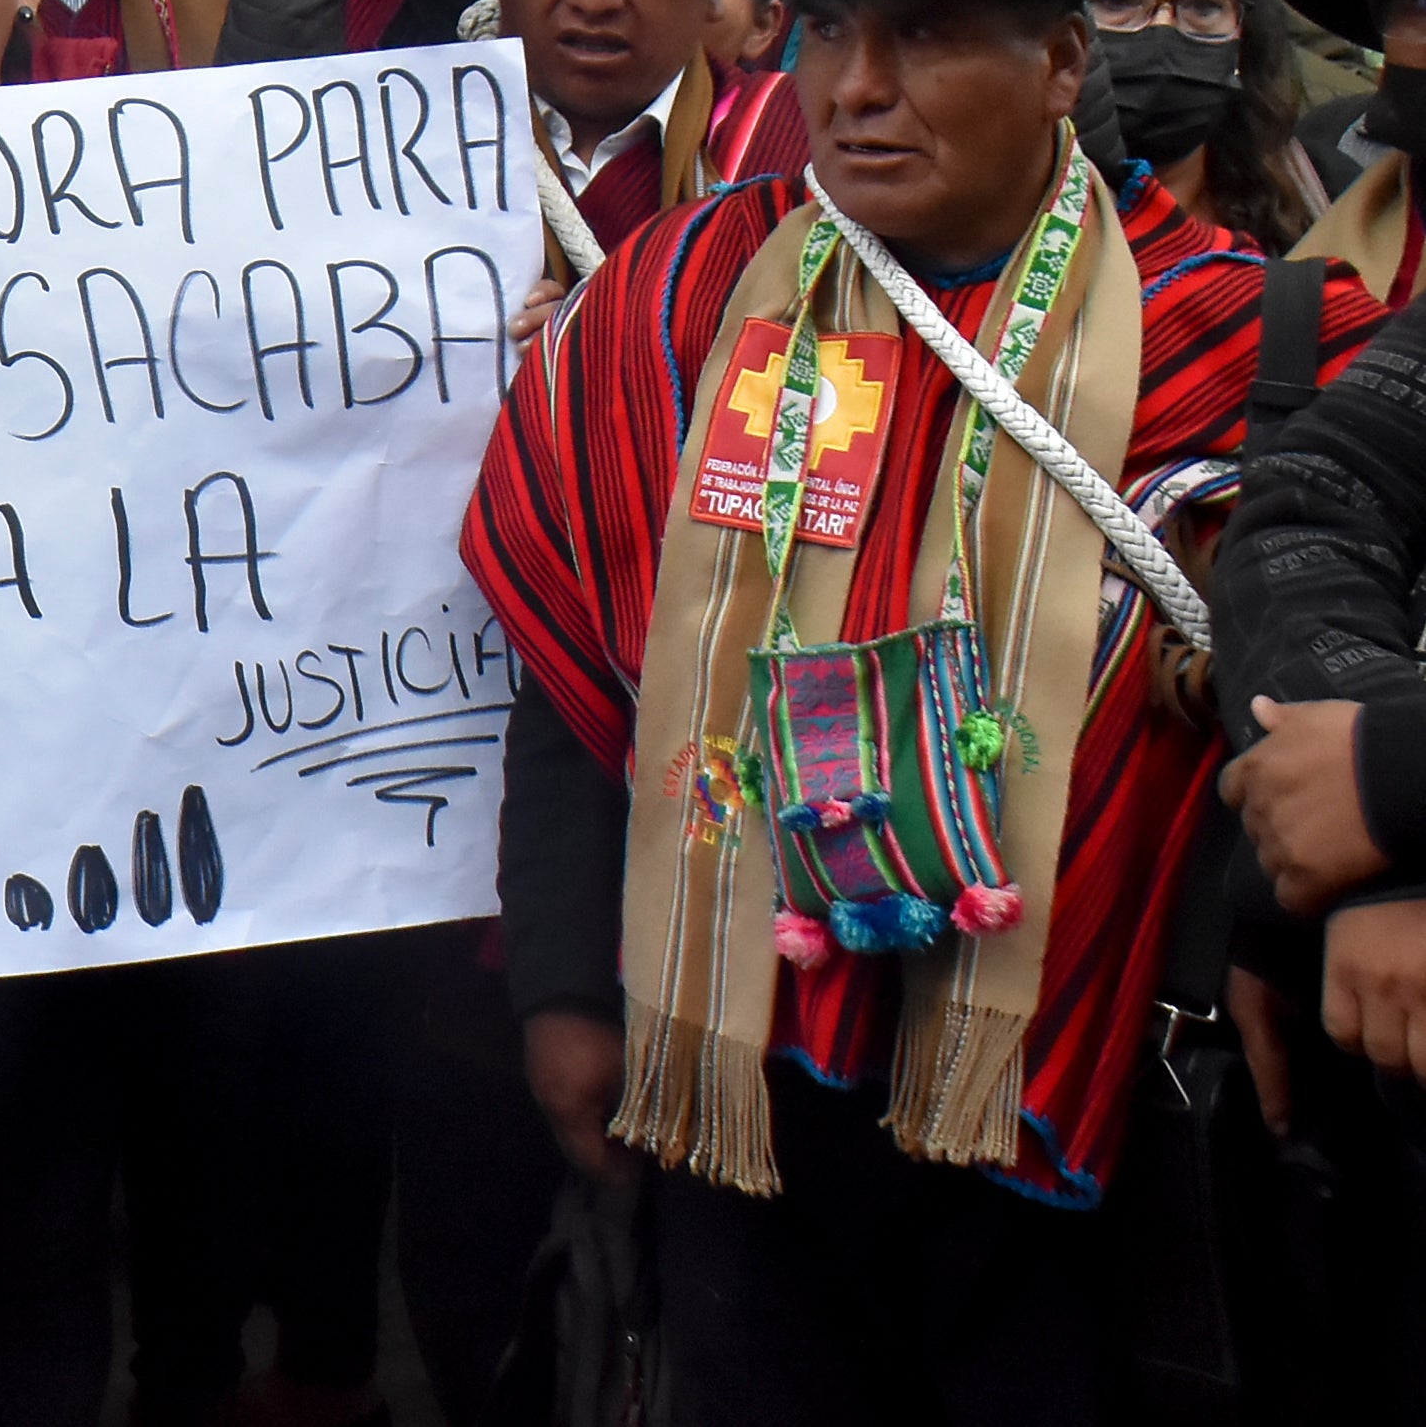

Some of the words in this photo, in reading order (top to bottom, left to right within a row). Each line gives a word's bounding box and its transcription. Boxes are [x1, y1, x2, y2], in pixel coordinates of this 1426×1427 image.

[247, 66, 510, 231] PARA
[701, 474, 714, 486] DE
[705, 457, 757, 478] FEDERACIÓN
[109, 470, 278, 635] LA
